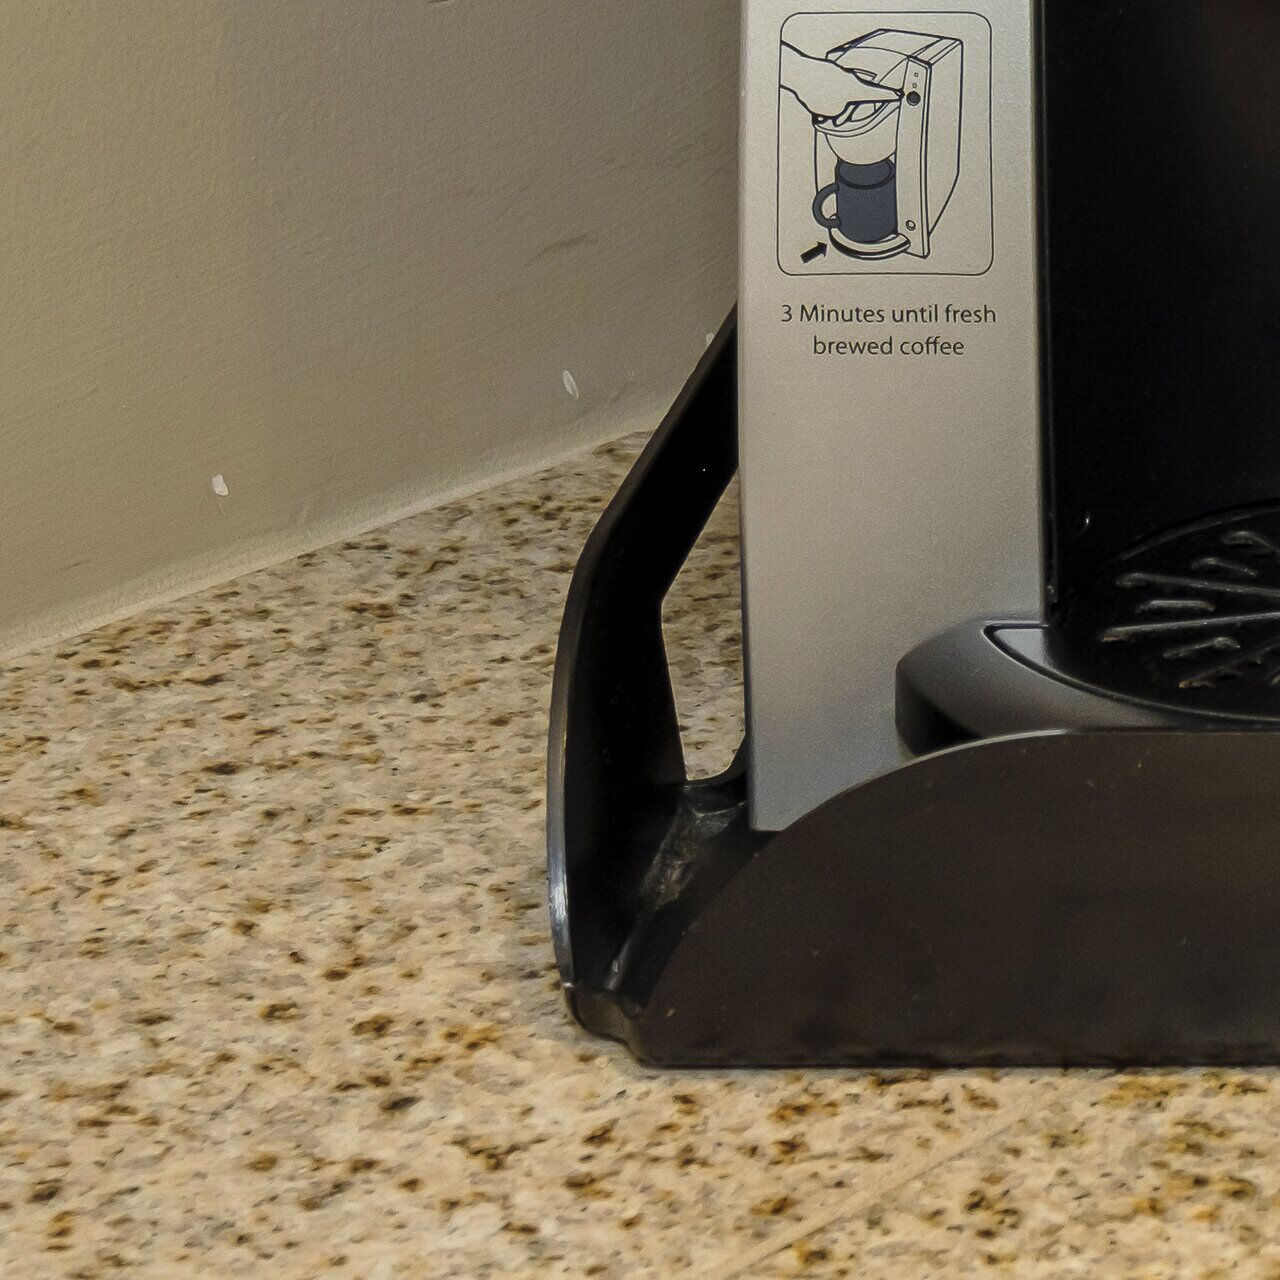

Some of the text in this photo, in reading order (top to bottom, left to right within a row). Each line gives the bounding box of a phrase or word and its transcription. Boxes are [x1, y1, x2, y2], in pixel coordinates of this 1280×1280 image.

[781, 303, 997, 323] 3 Minutes until fresh
[813, 335, 965, 355] brewed coffee
